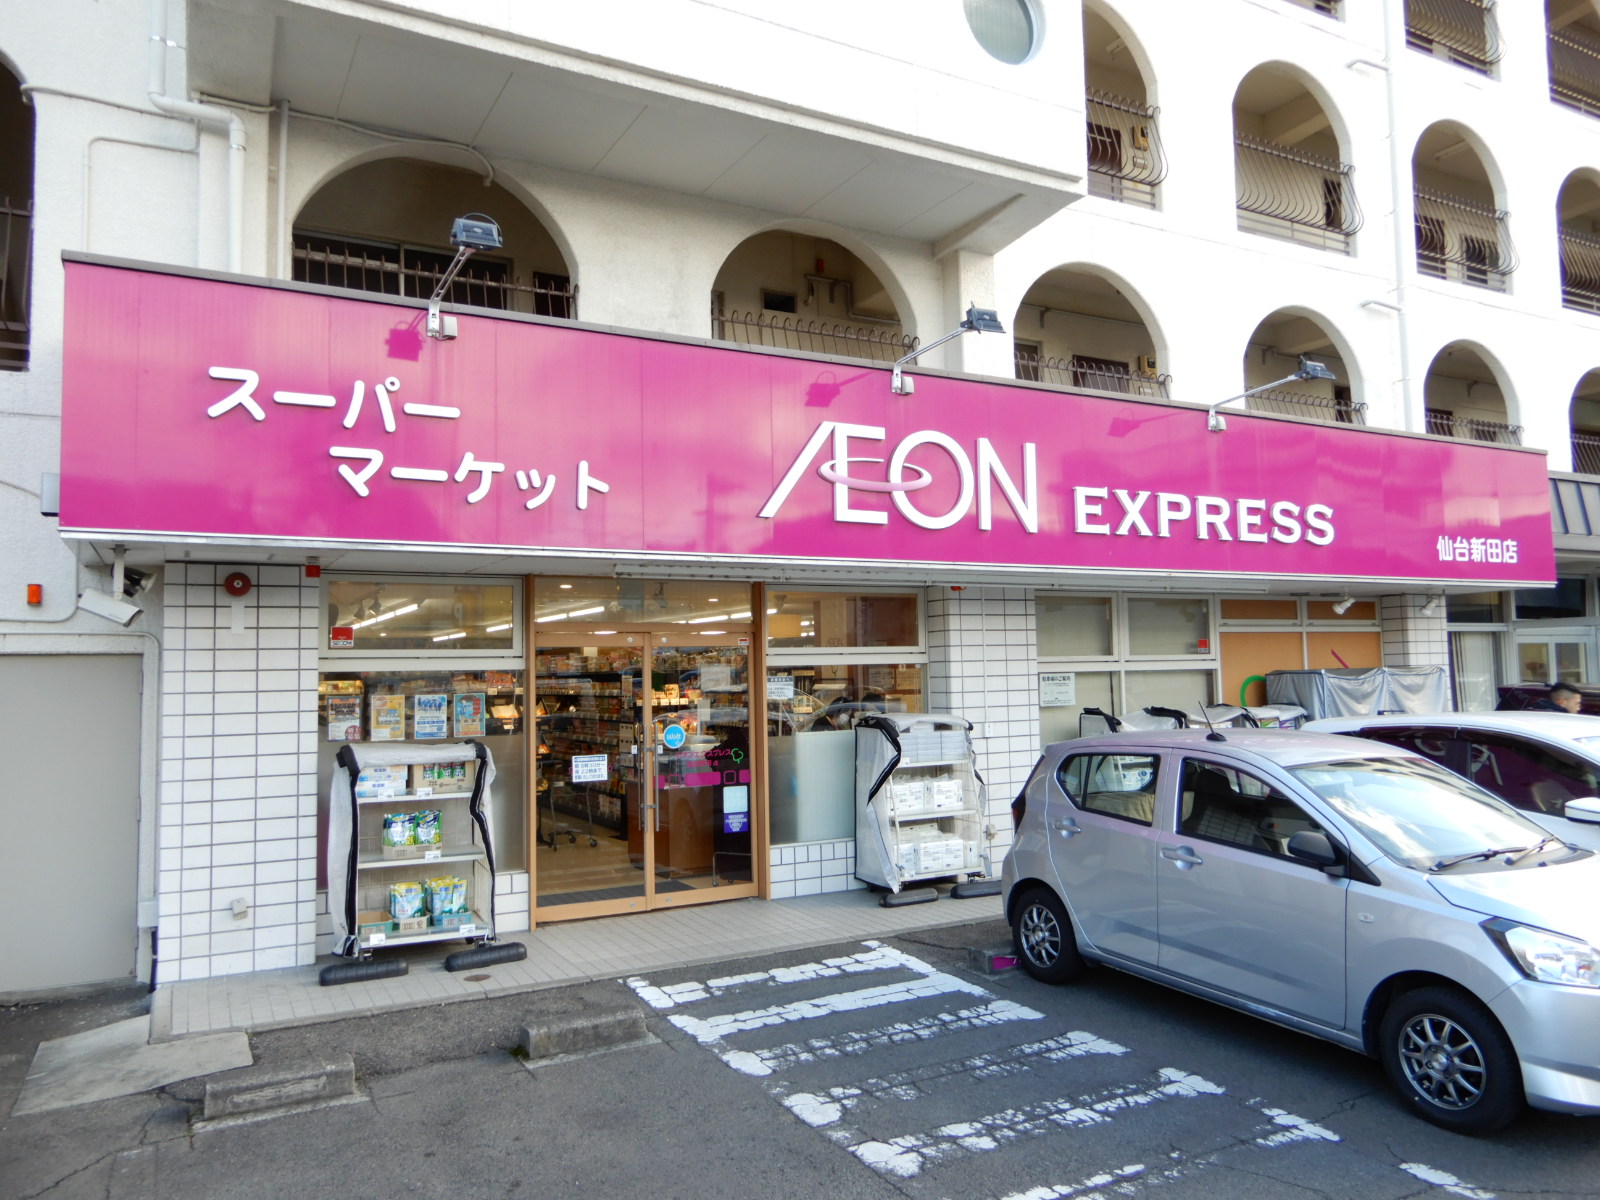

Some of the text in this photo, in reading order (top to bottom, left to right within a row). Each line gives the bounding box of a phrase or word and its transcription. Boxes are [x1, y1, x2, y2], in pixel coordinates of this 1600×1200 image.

[207, 366, 461, 433] スーパー
[329, 446, 611, 511] マーケット
[1072, 485, 1336, 547] EXPRESS
[1436, 535, 1519, 564] 仙台新田店
